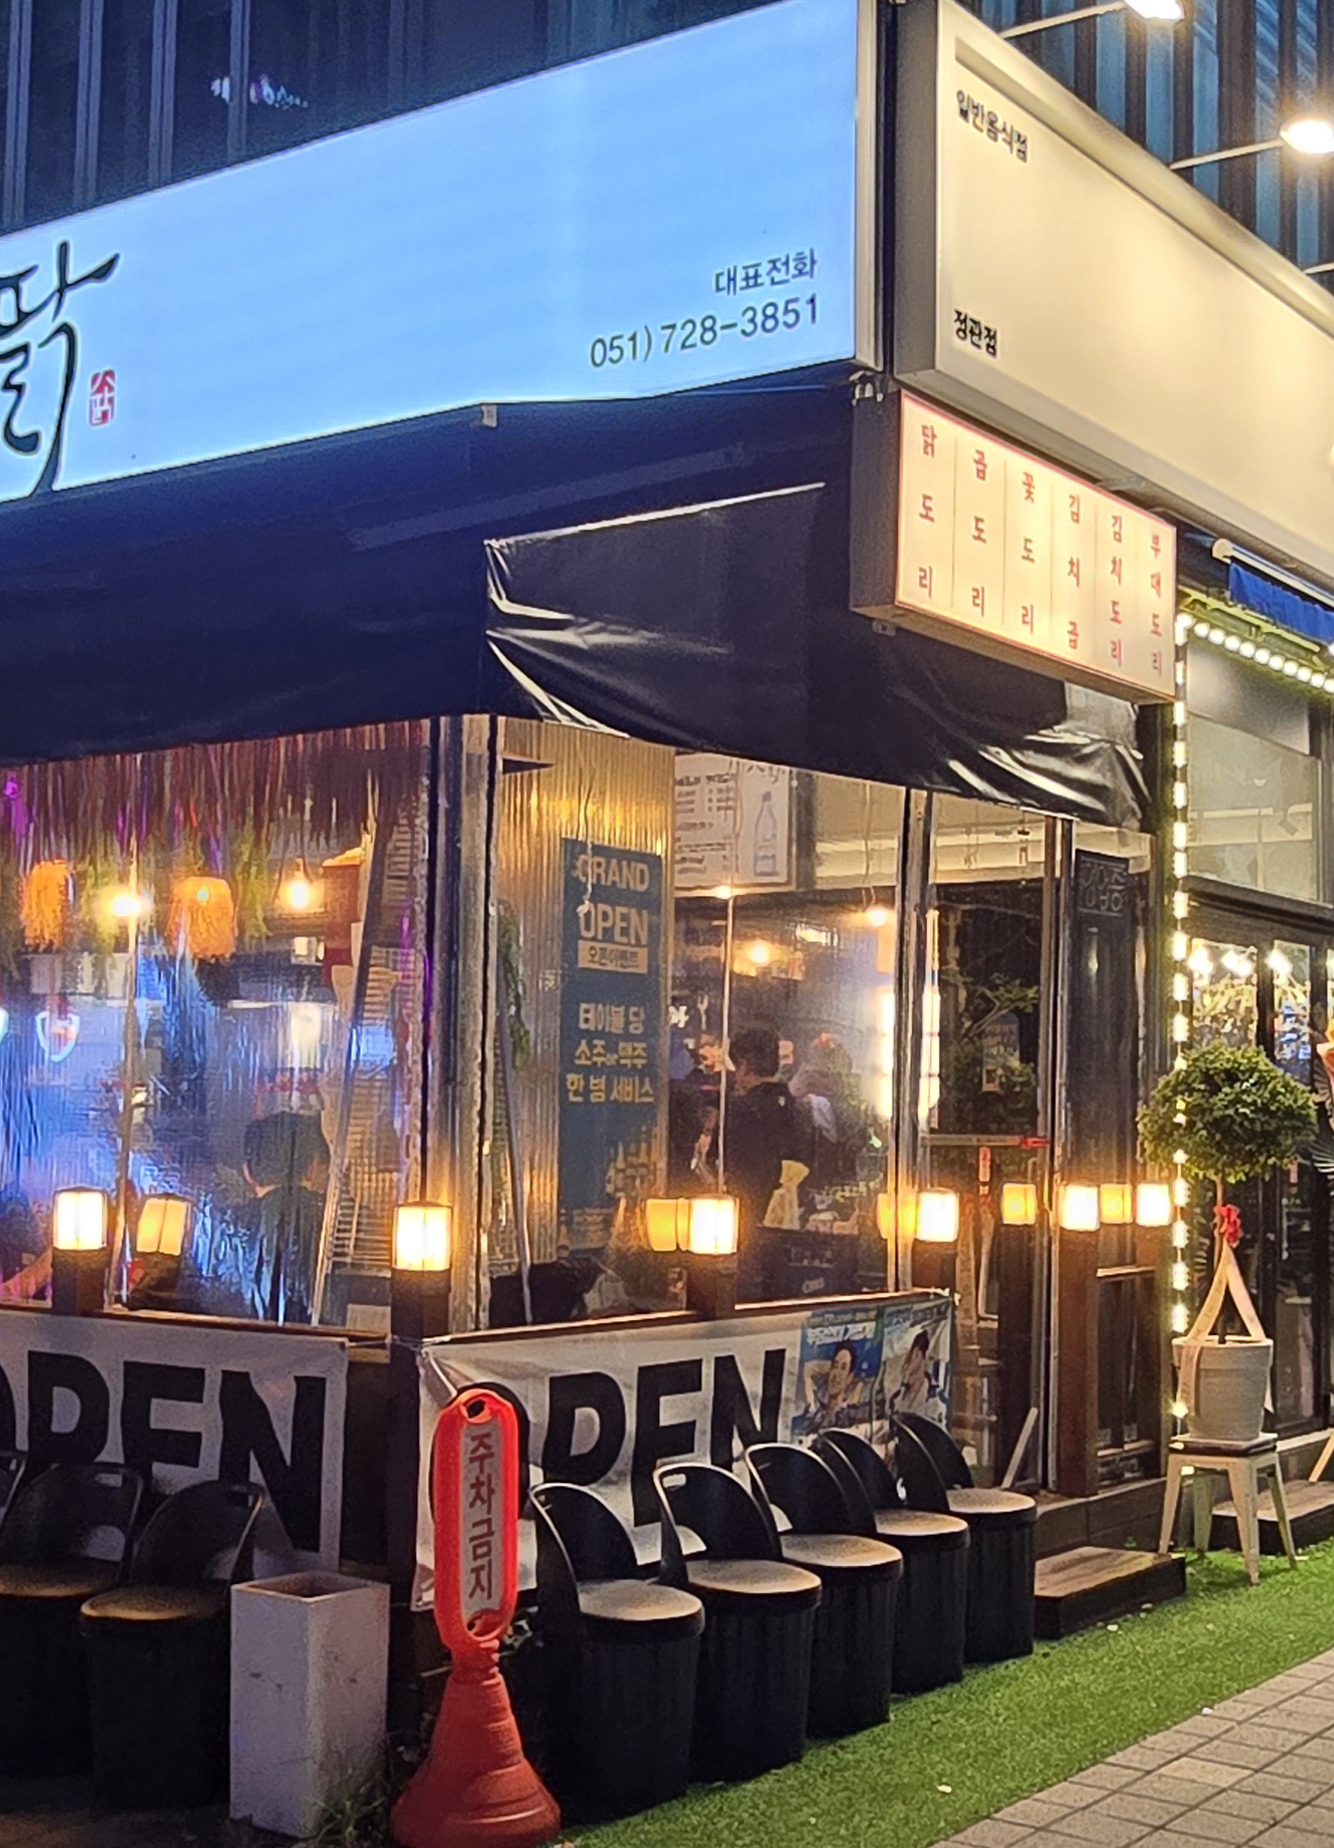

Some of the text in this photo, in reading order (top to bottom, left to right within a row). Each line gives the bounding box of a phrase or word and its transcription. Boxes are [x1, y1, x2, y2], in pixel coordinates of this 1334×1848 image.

[956, 90, 1028, 163] 일반음식점
[714, 247, 817, 296] 대표전화
[954, 308, 997, 359] 정관점
[919, 424, 938, 600] 닭도리
[1110, 515, 1123, 668] 김치도리
[578, 853, 649, 893] GRAND
[578, 903, 648, 946] OPEN
[579, 1003, 625, 1034] 테이블
[629, 1007, 645, 1034] 당
[566, 1072, 654, 1103] 한 병 서비스
[467, 1428, 496, 1602] 주차금지
